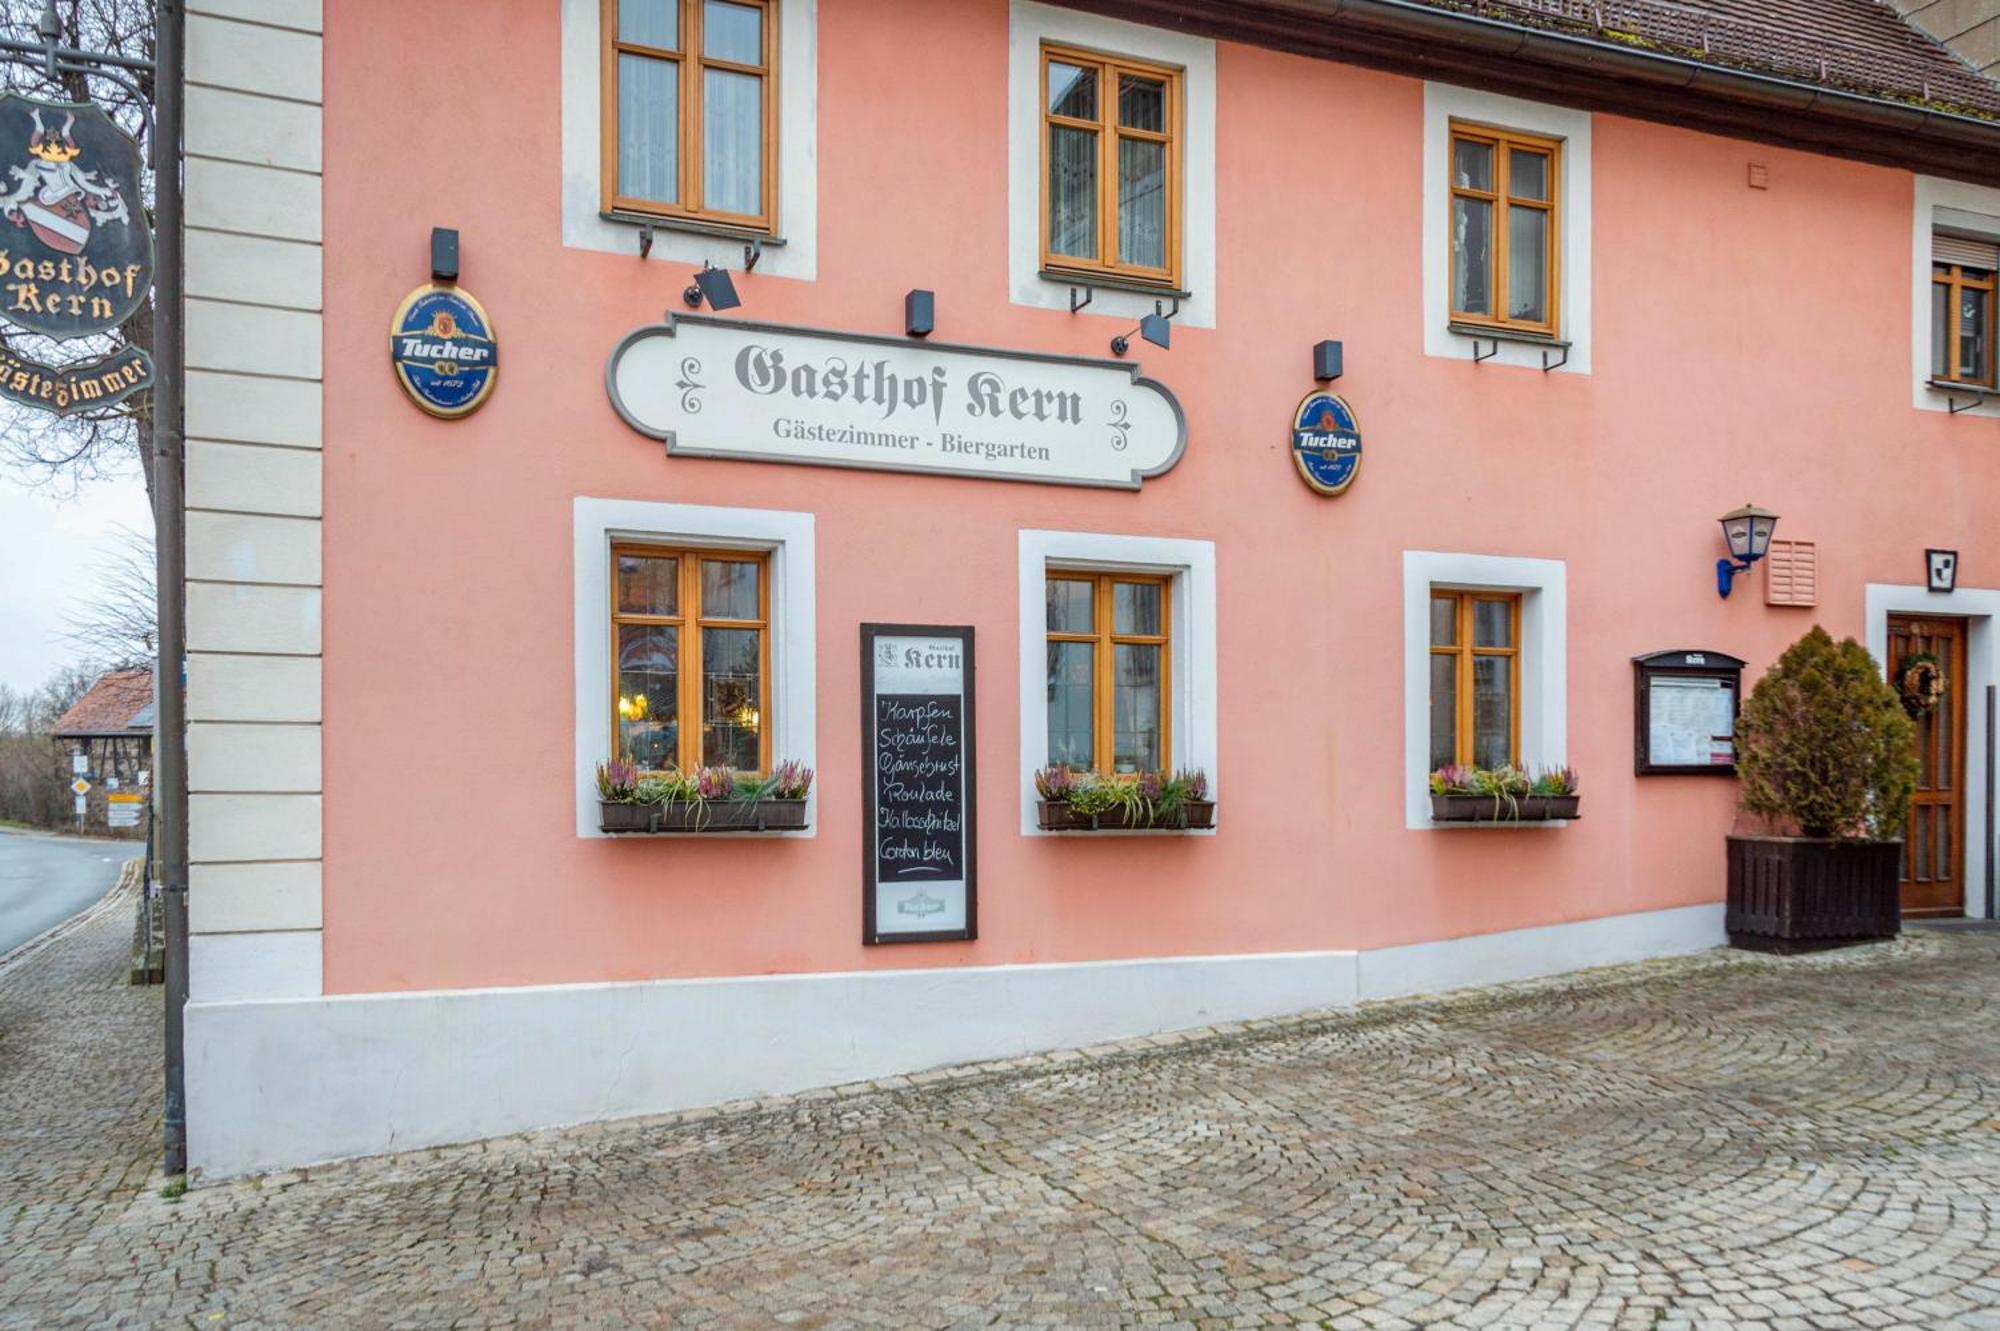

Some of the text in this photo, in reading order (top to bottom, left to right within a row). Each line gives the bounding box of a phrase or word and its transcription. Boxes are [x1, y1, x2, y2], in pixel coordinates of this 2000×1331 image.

[5, 282, 114, 320] Kern
[402, 338, 489, 361] Tucher
[0, 353, 147, 408] ästezimmer
[734, 344, 1083, 426] Gasthof Kern
[772, 417, 920, 450] Gästezimmer
[940, 432, 1051, 461] Biergarten
[1299, 432, 1357, 449] Tucher
[904, 647, 960, 670] Kern
[880, 700, 954, 730] Karpfen
[883, 780, 954, 803] Roulade
